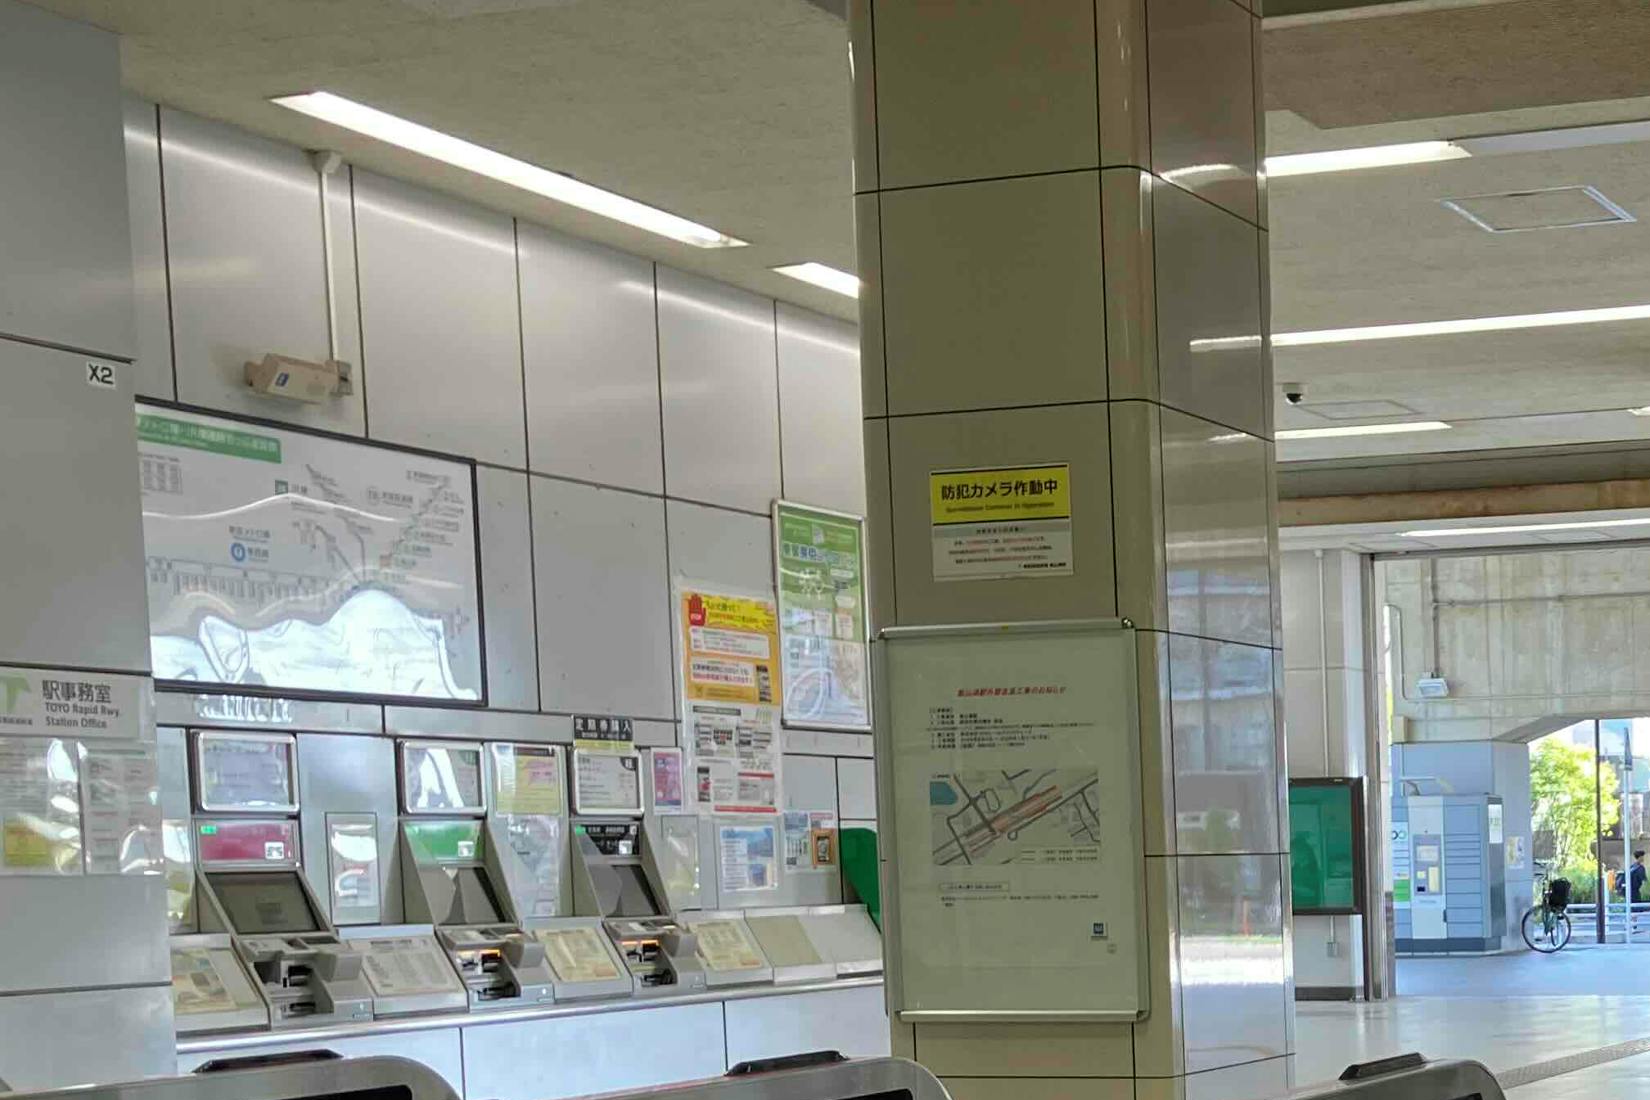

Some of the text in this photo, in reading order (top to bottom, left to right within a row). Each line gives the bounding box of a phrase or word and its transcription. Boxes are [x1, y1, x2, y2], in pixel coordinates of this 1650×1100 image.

[88, 364, 114, 385] X2
[942, 480, 1058, 500] 防犯カメラ作動中
[42, 680, 111, 703] 駅事務室
[45, 716, 79, 727] Station
[81, 718, 107, 728] Office
